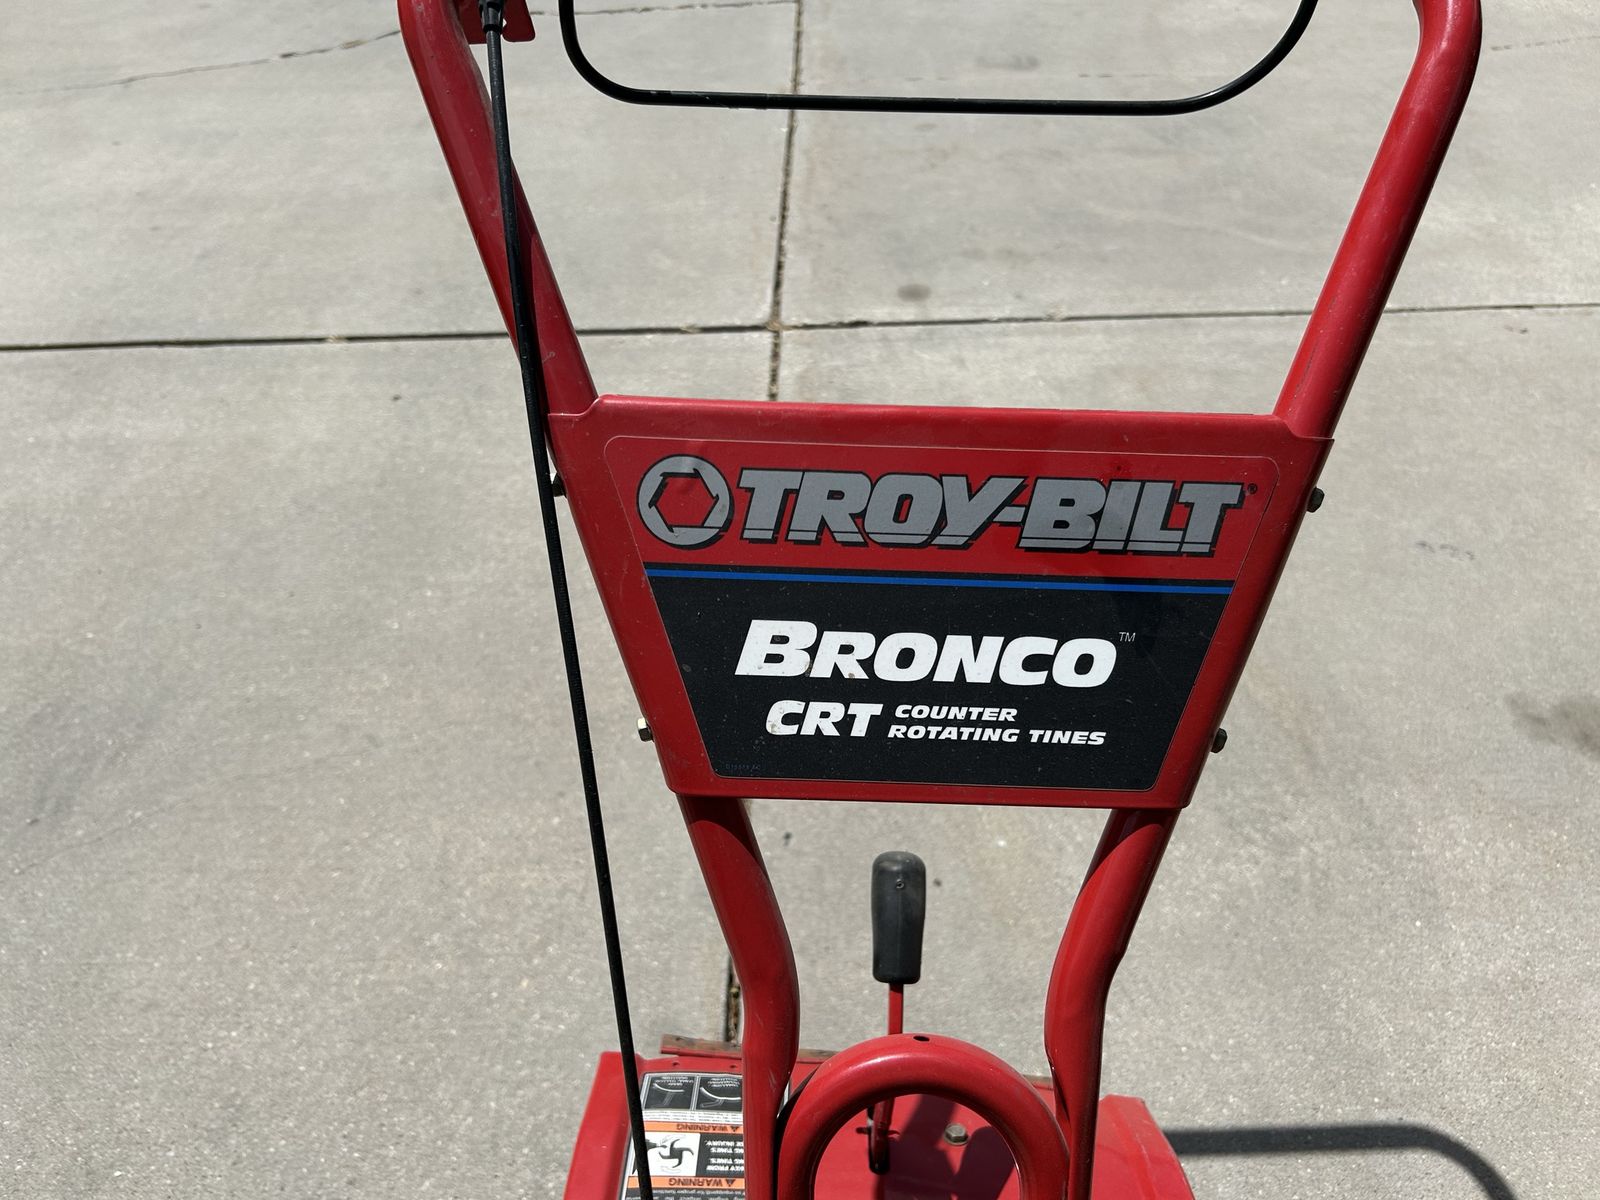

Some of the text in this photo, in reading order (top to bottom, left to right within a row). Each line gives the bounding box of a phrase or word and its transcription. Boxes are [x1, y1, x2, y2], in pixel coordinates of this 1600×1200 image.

[737, 468, 1245, 557] TROY-BILT
[734, 619, 1117, 688] BRONCO
[765, 700, 1018, 737] CRT COUNTER
[887, 725, 1106, 745] ROTATING TINES
[676, 1123, 728, 1132] WARNING
[668, 1177, 722, 1187] WARNING
